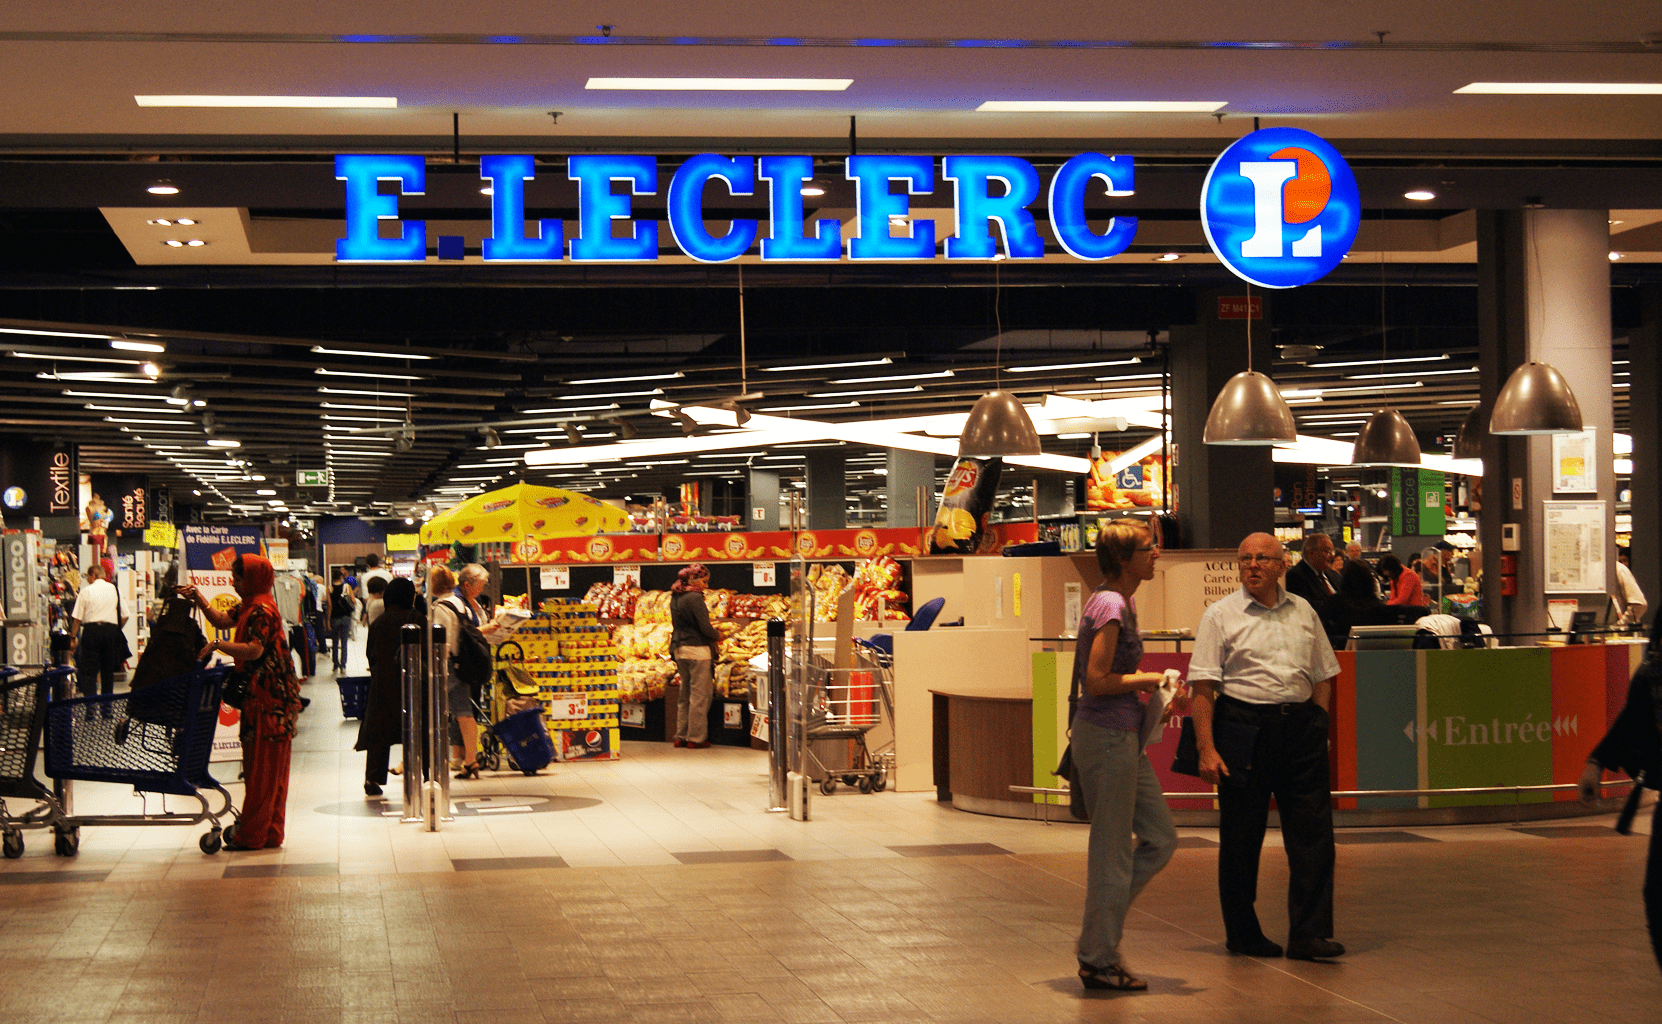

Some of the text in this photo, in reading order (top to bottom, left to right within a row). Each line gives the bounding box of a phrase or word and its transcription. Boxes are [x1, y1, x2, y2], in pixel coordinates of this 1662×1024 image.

[50, 452, 70, 513] Textile
[1291, 481, 1303, 508] Pain
[122, 494, 134, 529] Santé
[133, 487, 146, 529] Beauté
[1405, 477, 1418, 534] espace
[186, 524, 202, 533] Avec
[211, 526, 229, 534] Carte
[186, 535, 195, 544] de
[221, 535, 256, 545] E.LECLERC
[10, 540, 27, 614] Lenco
[189, 575, 210, 586] TOUS
[212, 576, 227, 586] LES
[1203, 574, 1231, 583] Carte
[1204, 562, 1240, 571] ACCU
[1442, 713, 1552, 746] Entrée
